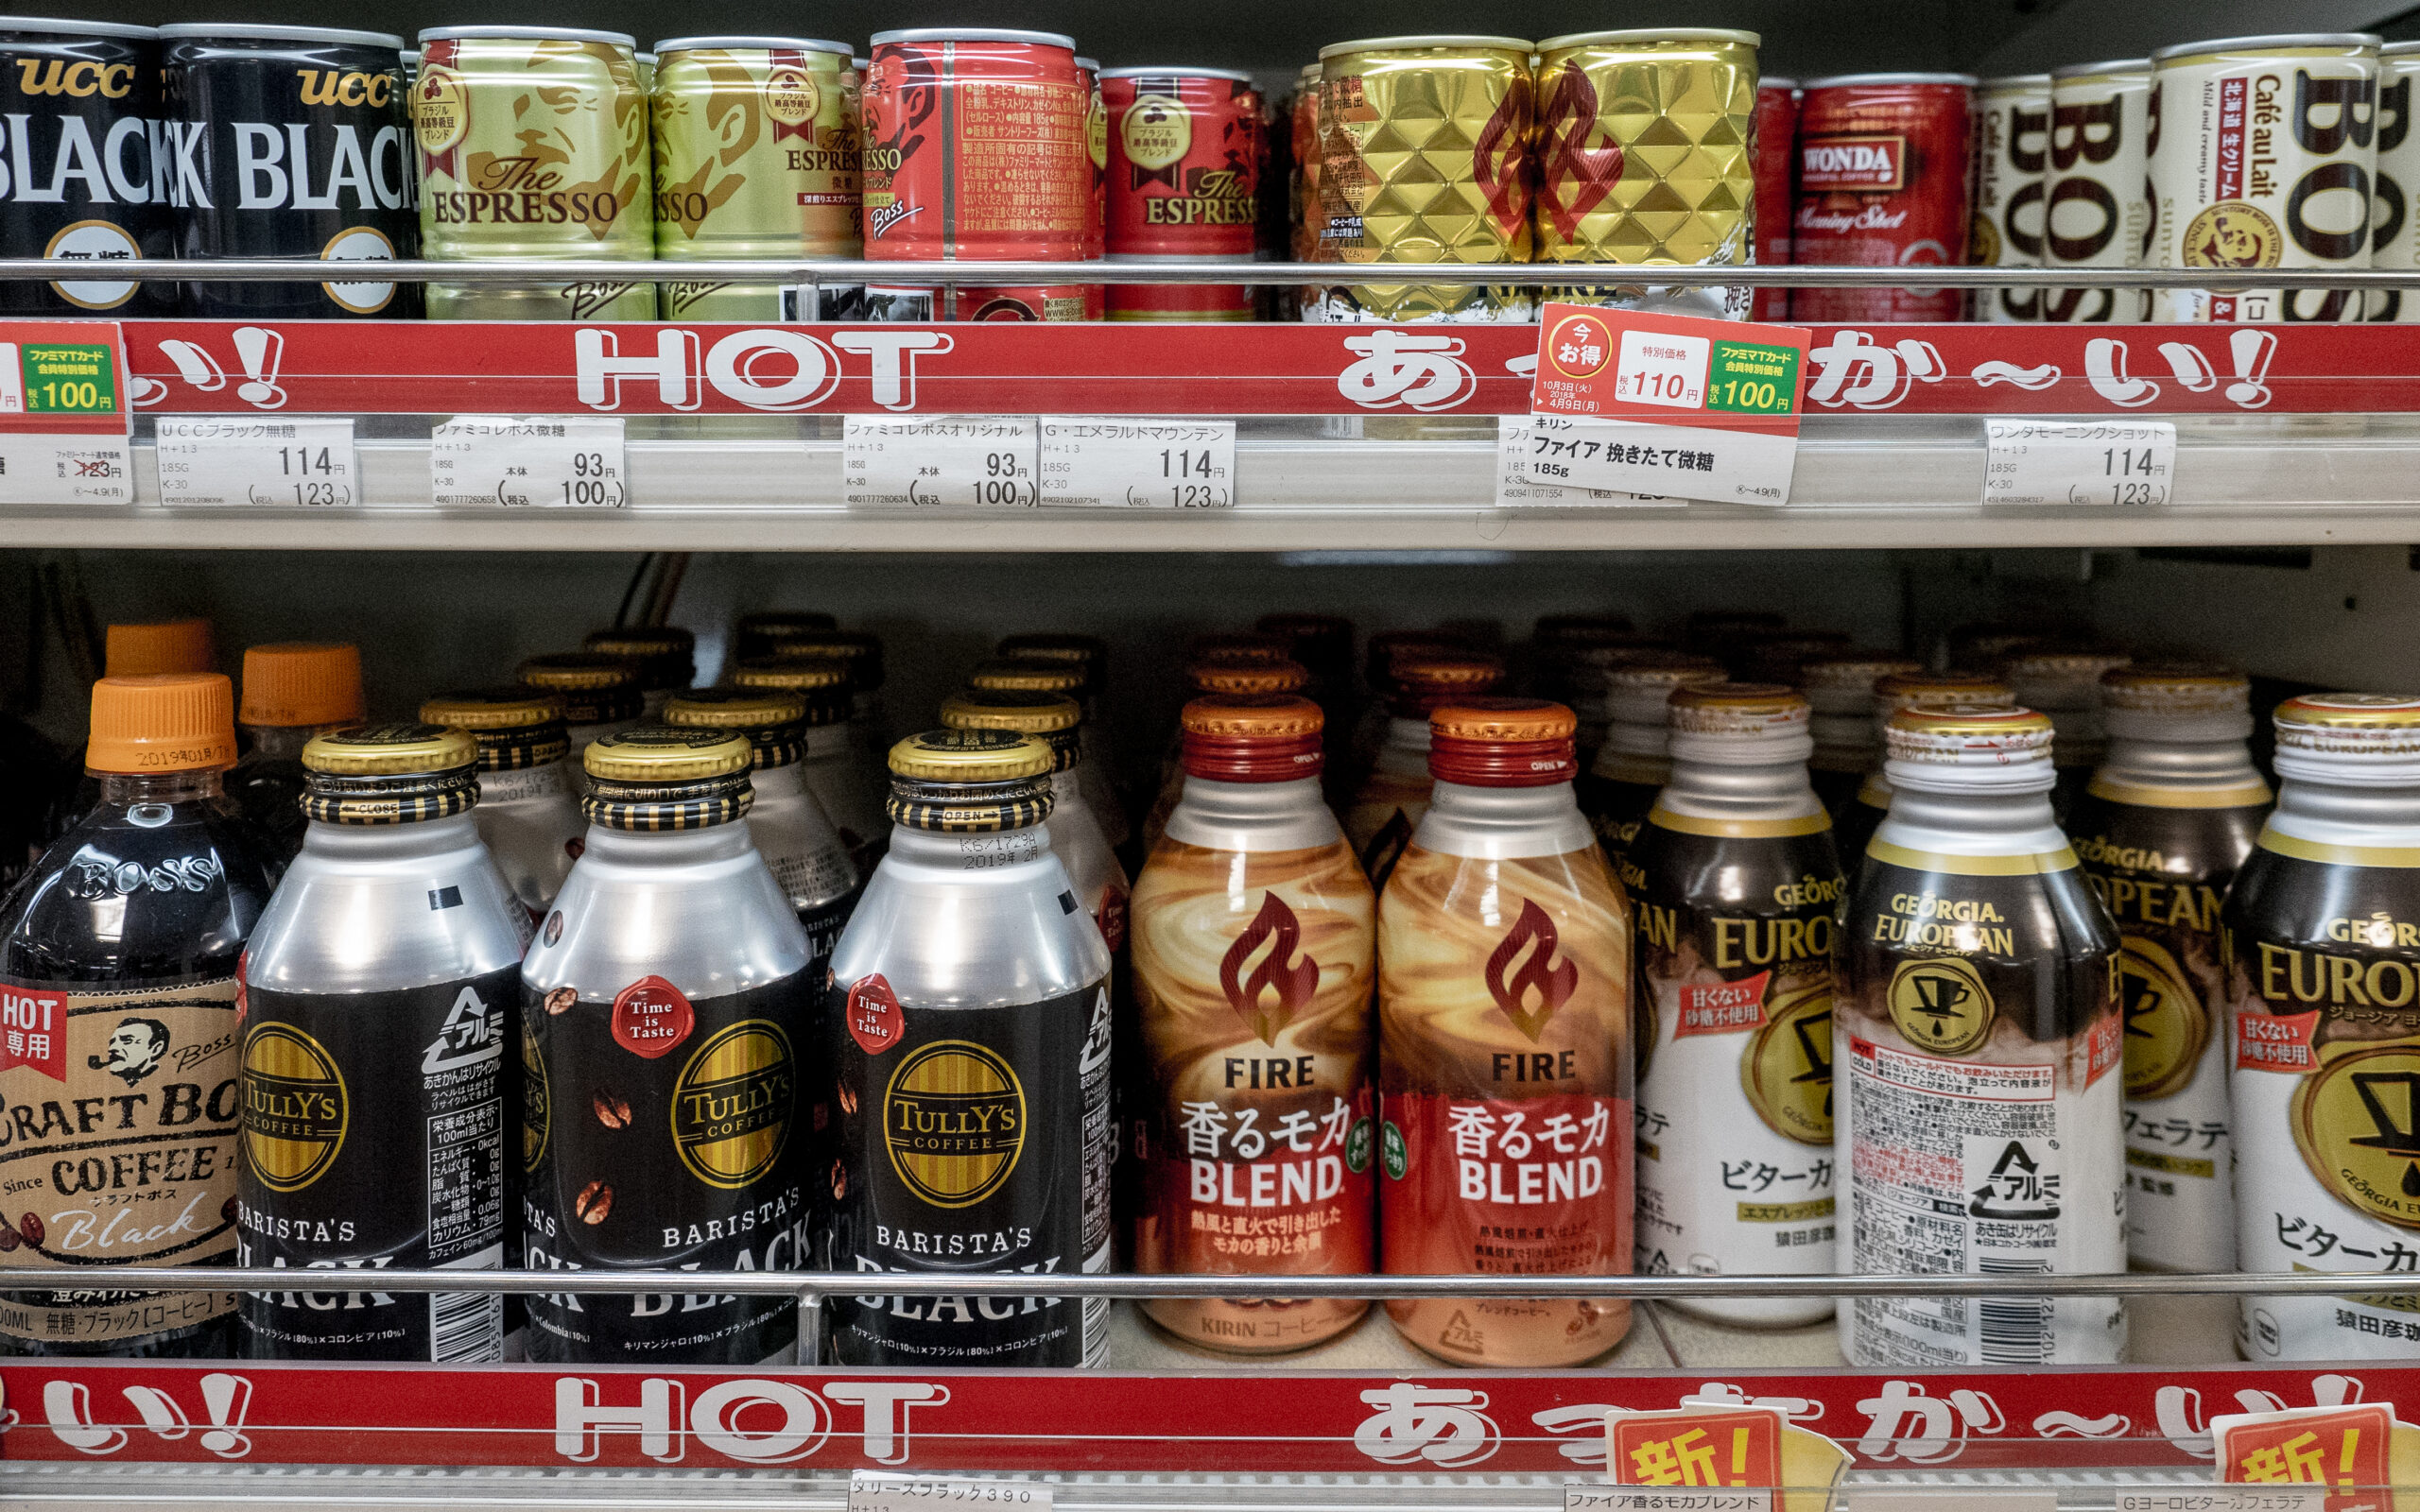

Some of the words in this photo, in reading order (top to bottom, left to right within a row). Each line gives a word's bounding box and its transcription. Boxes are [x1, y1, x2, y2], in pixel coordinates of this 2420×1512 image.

[2222, 80, 2243, 128] 北海道
[2254, 74, 2281, 125] Café
[2252, 126, 2272, 156] au
[1804, 146, 1892, 171] WONDA
[2221, 132, 2240, 195] 生クリーム
[478, 157, 563, 190] The
[2250, 158, 2278, 198] Lait
[432, 192, 617, 223] ESPRESSO
[1573, 322, 1592, 343] 今
[1558, 342, 1601, 367] お得
[1642, 346, 1687, 360] 特別価格
[1720, 347, 1792, 364] ファミマTカード
[575, 329, 954, 411] HOT
[1725, 361, 1784, 377] 会員特別価格
[1617, 375, 1629, 395] 税込
[1708, 384, 1720, 404] 税込
[1535, 417, 1573, 431] キリン
[1534, 436, 1601, 459] ファイア
[1606, 441, 1714, 472] 挽きたて微糖
[162, 463, 189, 472] 185G
[435, 460, 454, 469] 185G
[506, 466, 528, 476] 本体
[847, 461, 866, 470] 185G
[918, 466, 941, 476] 本体
[1043, 462, 1071, 472] 185G
[1533, 462, 1569, 477] 185g
[1990, 464, 2016, 472] 185G
[163, 480, 188, 490] K-30
[435, 477, 454, 486] K-30
[846, 477, 866, 486] K-30
[1042, 479, 1067, 489] K-30
[1988, 480, 2013, 489] K-30
[359, 803, 398, 815] CLOSE
[945, 811, 981, 821] OPEN
[1875, 913, 2014, 957] EUROPAN
[630, 1002, 673, 1015] Time
[857, 994, 888, 1014] Time
[1691, 988, 1752, 1008] 甘くない
[3, 993, 59, 1031] HOT
[645, 1015, 659, 1027] is
[866, 1011, 876, 1023] is
[456, 1011, 504, 1049] アルミ
[630, 1025, 675, 1040] Taste
[856, 1018, 888, 1038] Taste
[6, 1030, 50, 1059] 専用
[424, 1057, 502, 1090] あきかんはリサイクル
[1224, 1056, 1315, 1090] FIRE
[1492, 1050, 1577, 1082] FIRE
[245, 1078, 337, 1121] TULLY'S
[683, 1074, 790, 1125] TULLY'S
[252, 1118, 313, 1136] COFFEE
[893, 1099, 1016, 1134] TULLY'S
[1180, 1096, 1351, 1159] 香るモカ
[914, 1136, 993, 1150] COFFEE
[1448, 1101, 1610, 1160] 香るモカ
[3, 1176, 43, 1196] Since
[52, 1145, 217, 1196] COFFEE
[1190, 1155, 1342, 1208] BLEND
[1459, 1156, 1603, 1205] BLEND
[2003, 1175, 2061, 1201] アルミ
[51, 1192, 210, 1251] Black
[236, 1199, 355, 1243] BARISTA'S
[662, 1186, 800, 1248] BARISTA'S
[875, 1226, 1031, 1255] BARISTA'S
[1201, 1317, 1256, 1337] KIRIN
[556, 1376, 949, 1466] HOT
[1570, 1493, 1758, 1510] ファイア香るモカブレンド
